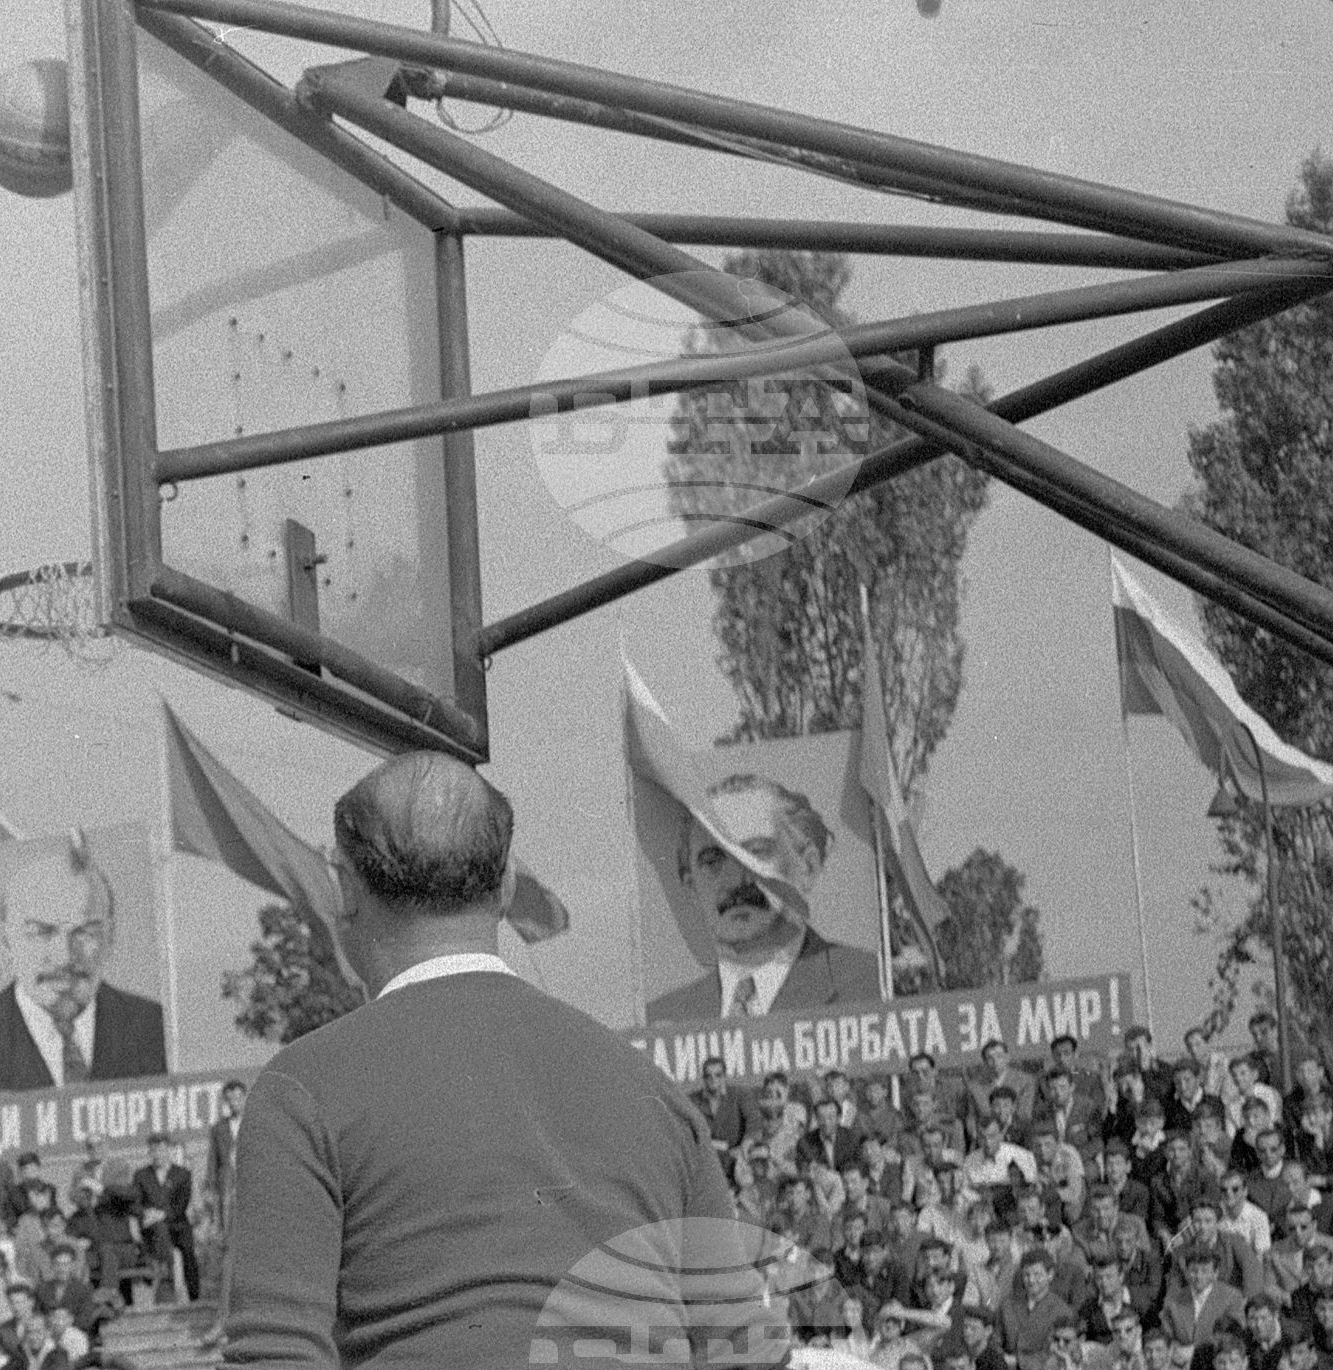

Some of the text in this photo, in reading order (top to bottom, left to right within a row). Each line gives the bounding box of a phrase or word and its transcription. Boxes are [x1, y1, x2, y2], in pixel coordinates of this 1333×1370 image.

[37, 1100, 57, 1146] И
[71, 1081, 231, 1142] СПОРТИСТ
[752, 1038, 790, 1075] НА
[794, 1007, 948, 1071] БОРБАТА
[958, 1002, 1003, 1052] ЗА
[1016, 977, 1121, 1046] МИР!
